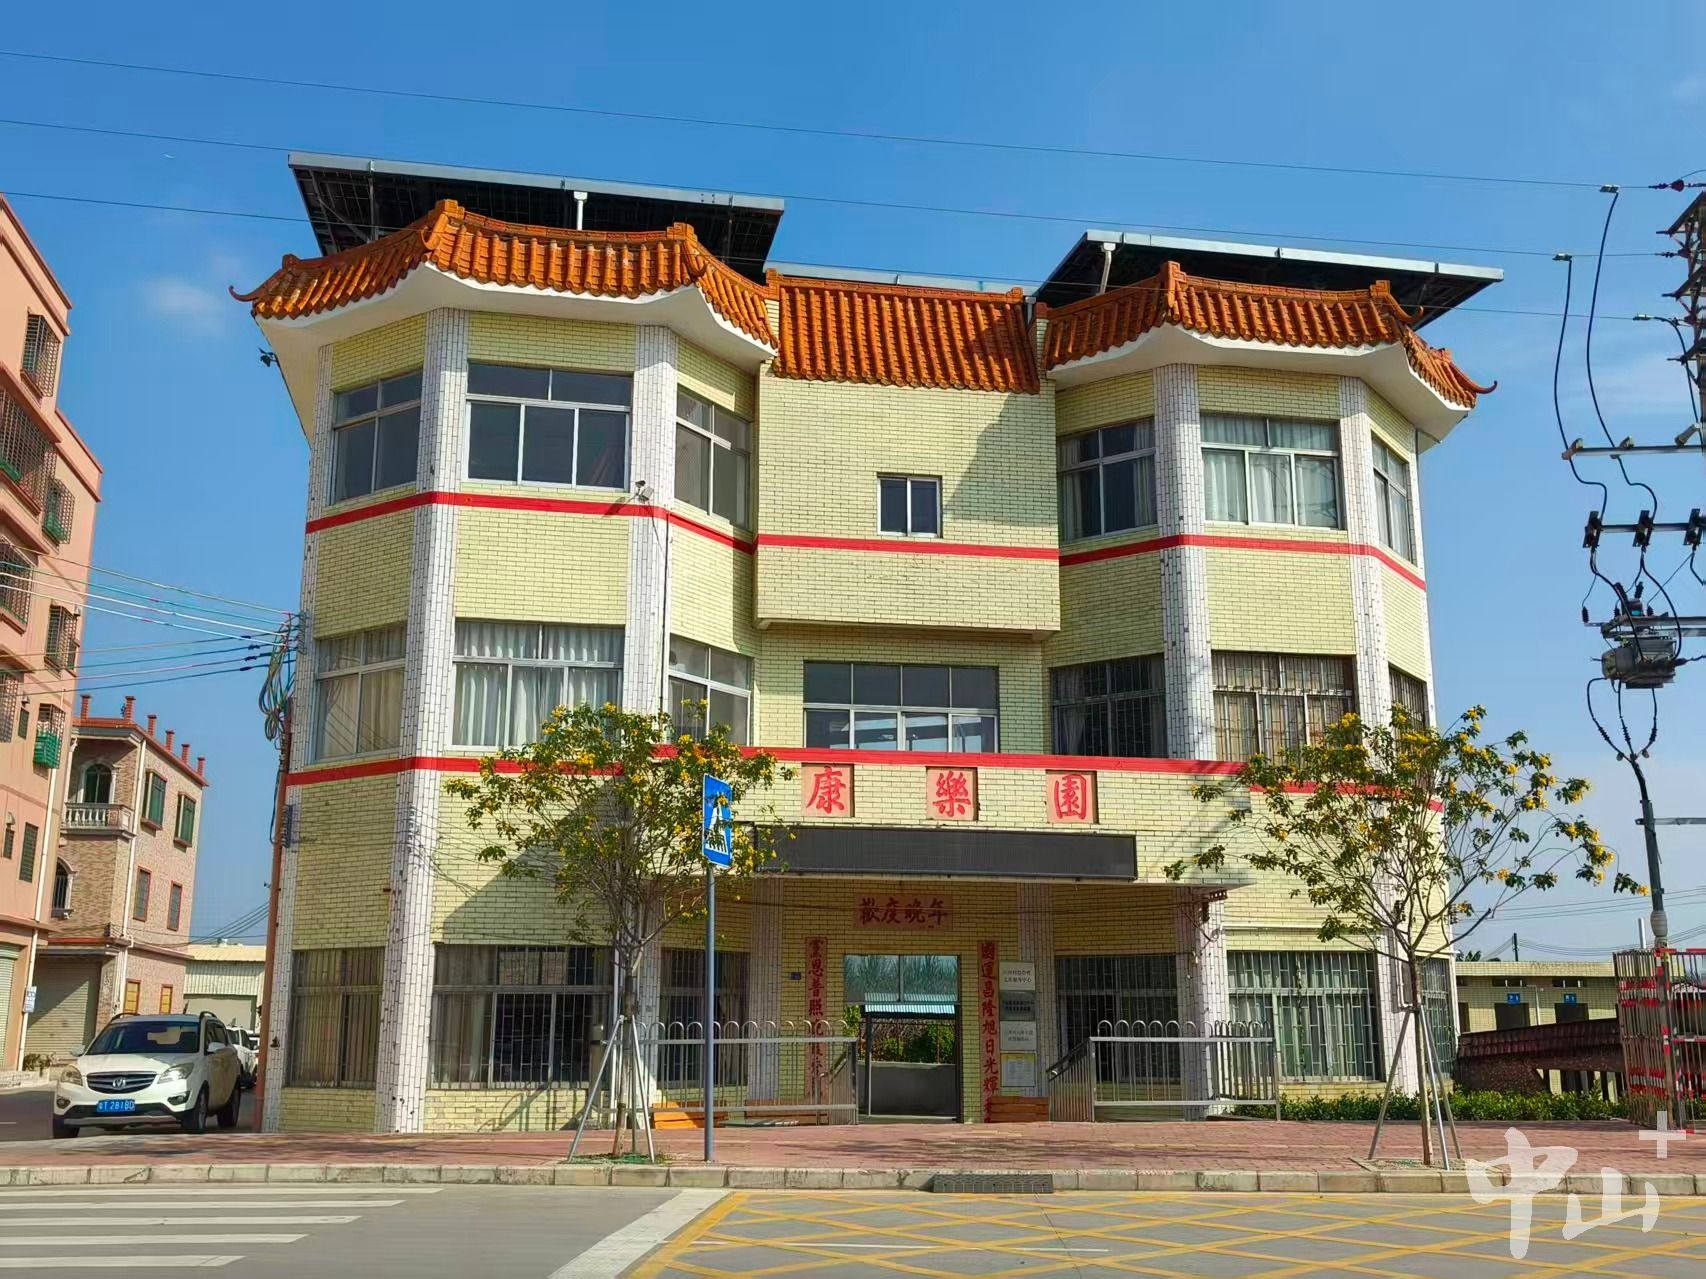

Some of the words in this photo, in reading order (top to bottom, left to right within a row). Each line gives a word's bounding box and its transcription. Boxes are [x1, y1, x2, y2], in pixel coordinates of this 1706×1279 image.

[806, 765, 1087, 820] 康樂園
[980, 942, 999, 1123] 國運昌隆旭日光輝
